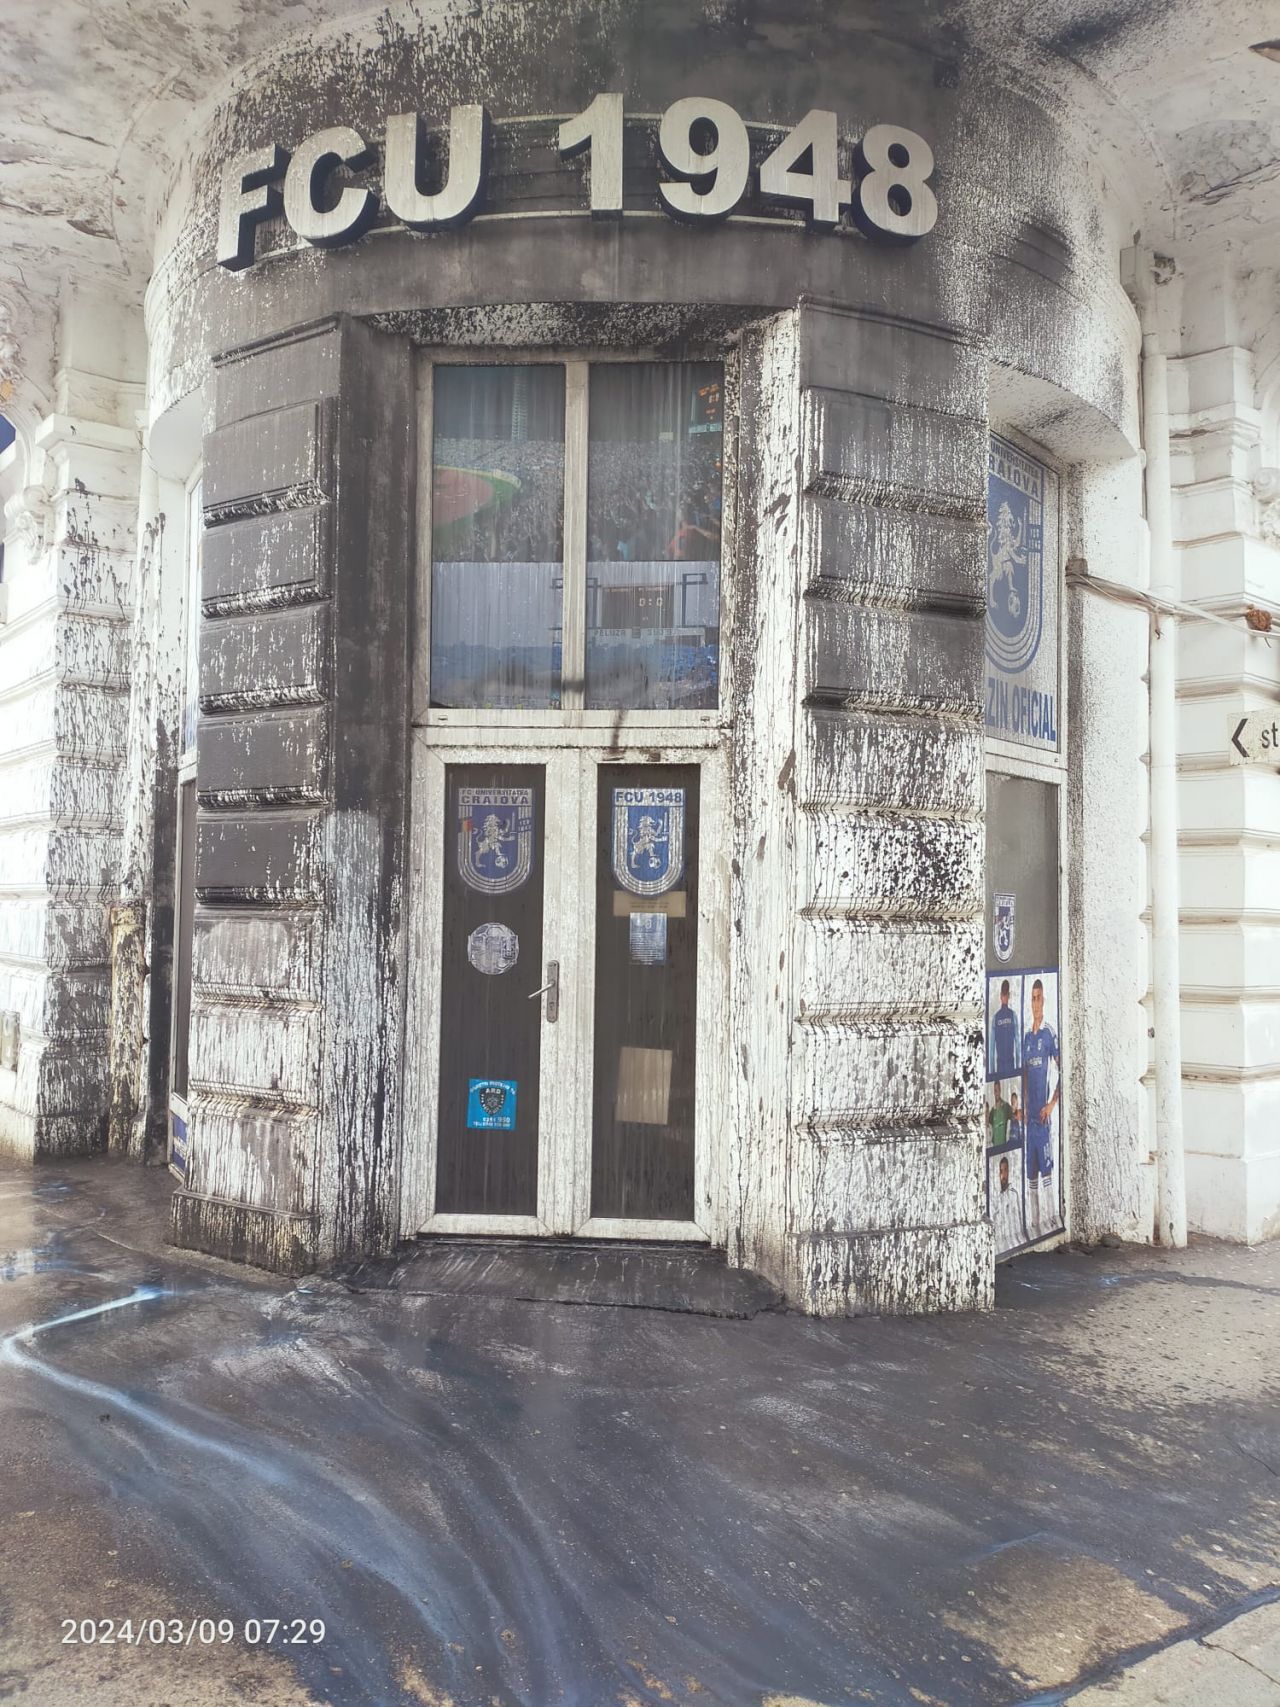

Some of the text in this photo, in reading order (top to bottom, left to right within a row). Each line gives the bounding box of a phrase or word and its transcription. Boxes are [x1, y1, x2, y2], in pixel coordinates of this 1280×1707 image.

[216, 92, 939, 268] FCU 1948
[1012, 684, 1057, 742] OFICIAL
[461, 795, 529, 805] CRAIOVA
[616, 791, 682, 803] FCU 1948
